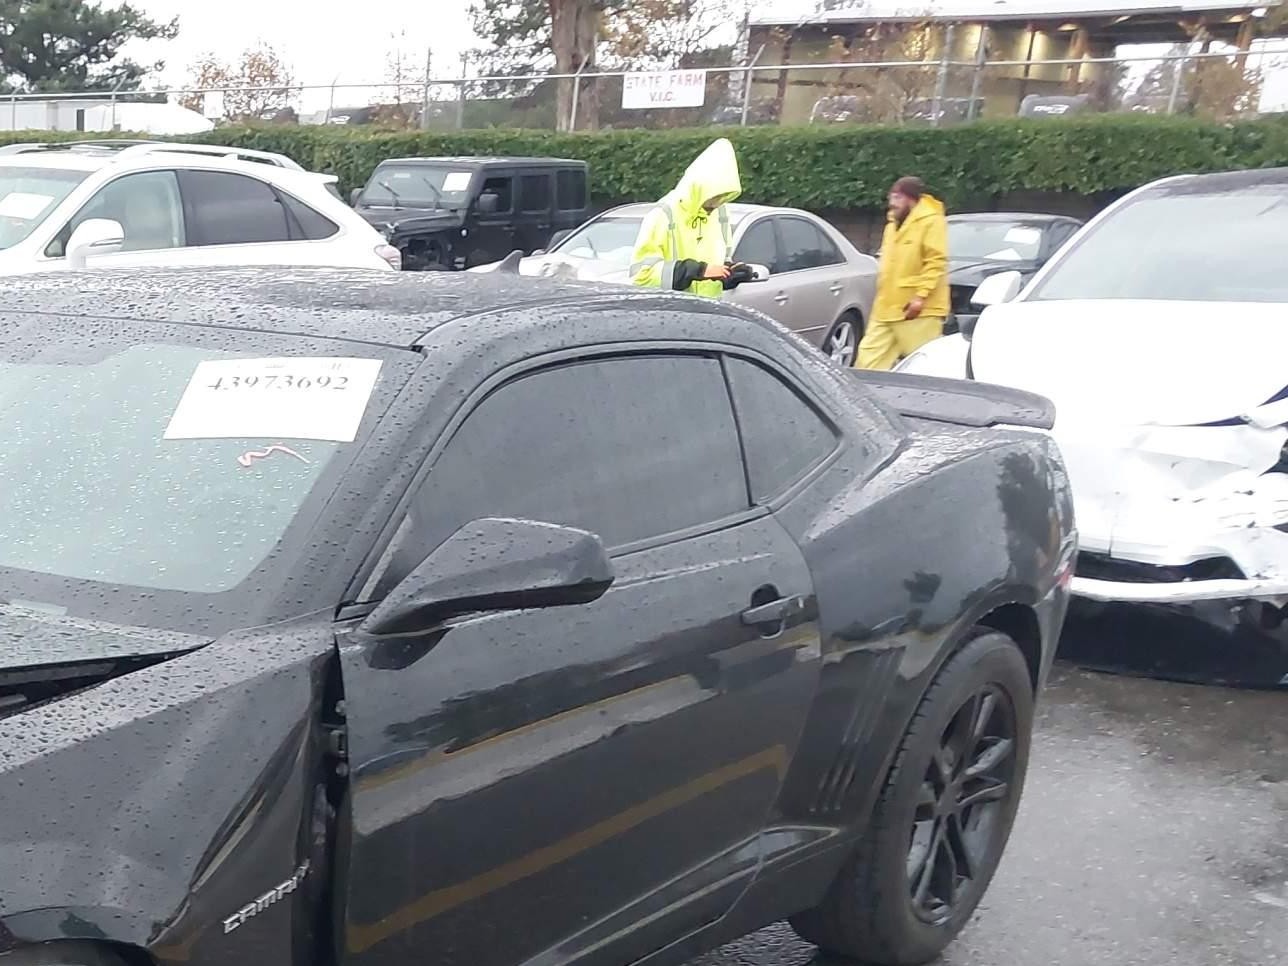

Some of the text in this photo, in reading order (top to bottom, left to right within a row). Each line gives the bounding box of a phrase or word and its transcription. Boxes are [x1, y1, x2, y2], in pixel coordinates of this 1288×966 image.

[626, 73, 703, 89] STATE FARM
[207, 375, 349, 390] 43973692
